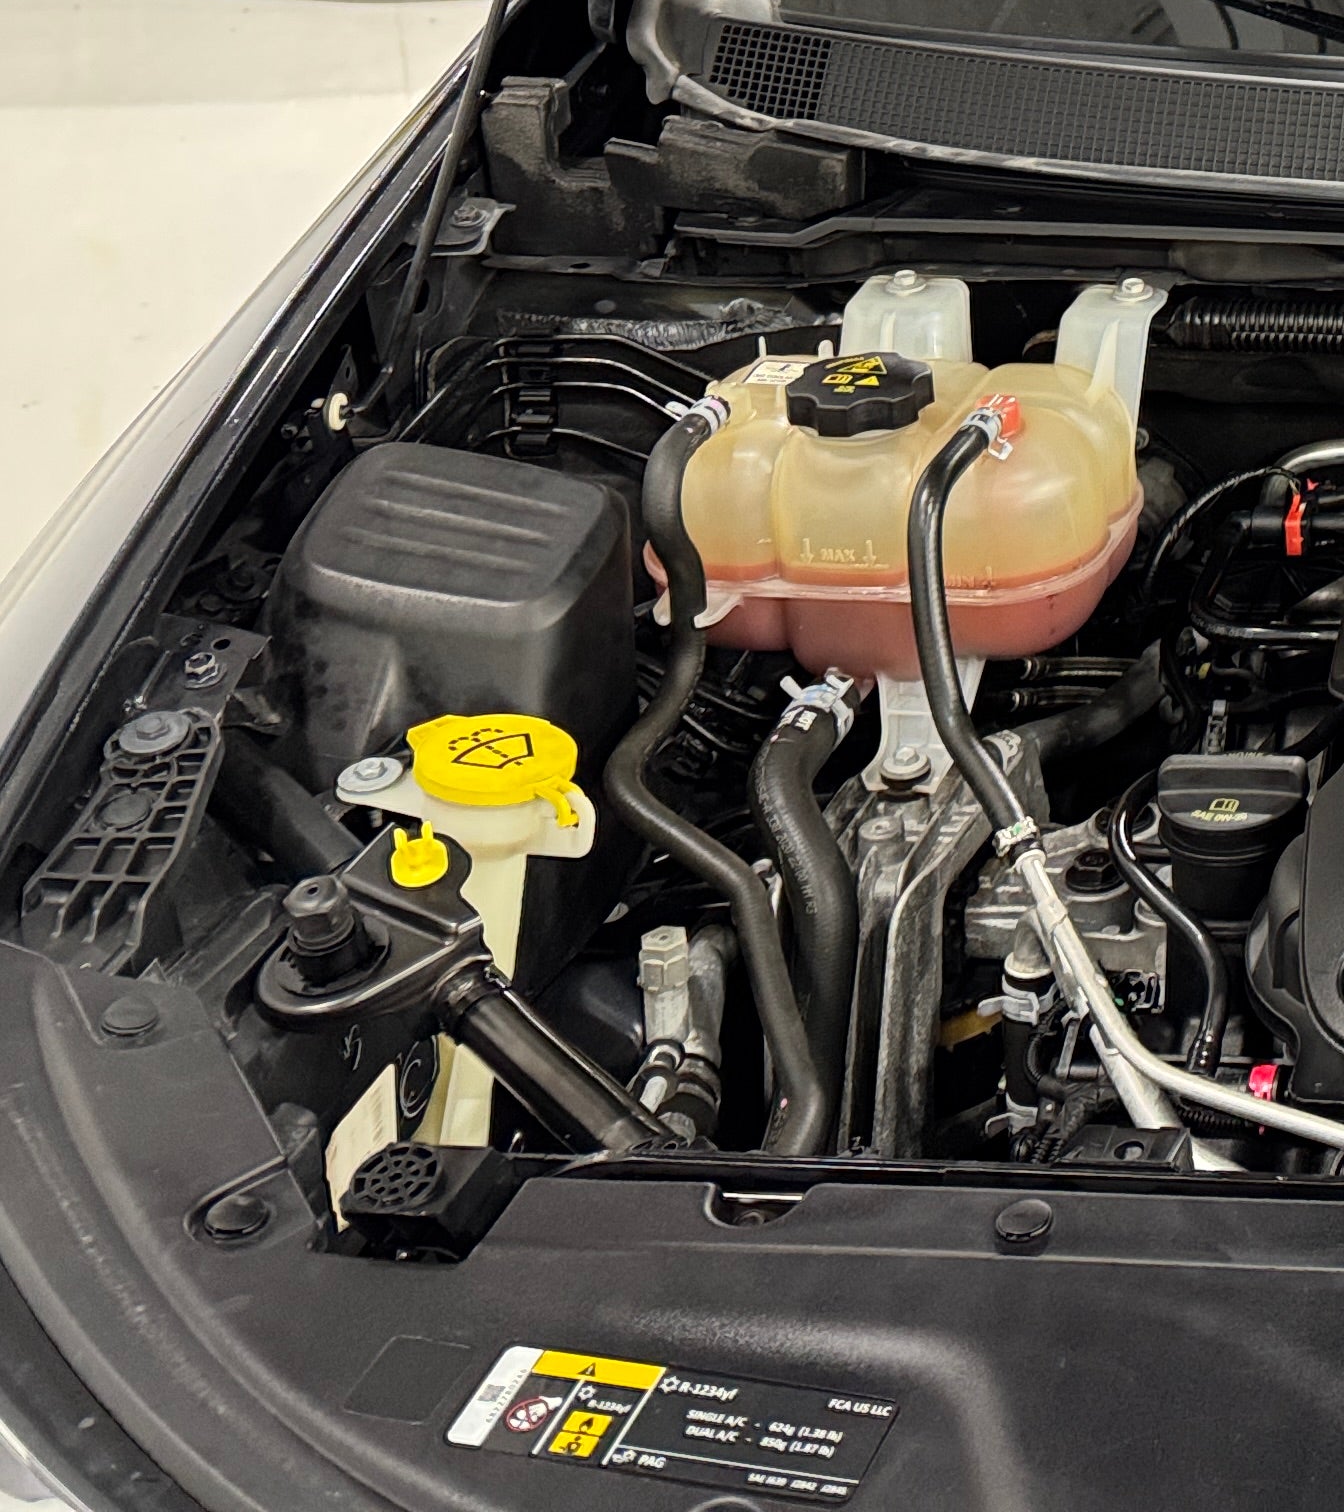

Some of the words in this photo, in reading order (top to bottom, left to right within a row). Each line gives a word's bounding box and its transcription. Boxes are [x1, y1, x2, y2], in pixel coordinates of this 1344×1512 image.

[820, 548, 856, 562] MAX
[679, 1381, 739, 1401] R-1234yf
[828, 1398, 851, 1412] FCA
[852, 1402, 870, 1414] US
[869, 1405, 893, 1417] LLC
[686, 1409, 723, 1424] SINGLE
[722, 1414, 748, 1428] A/C
[685, 1425, 717, 1439] DUAL
[717, 1430, 740, 1443] A/C
[637, 1453, 667, 1469] PAG
